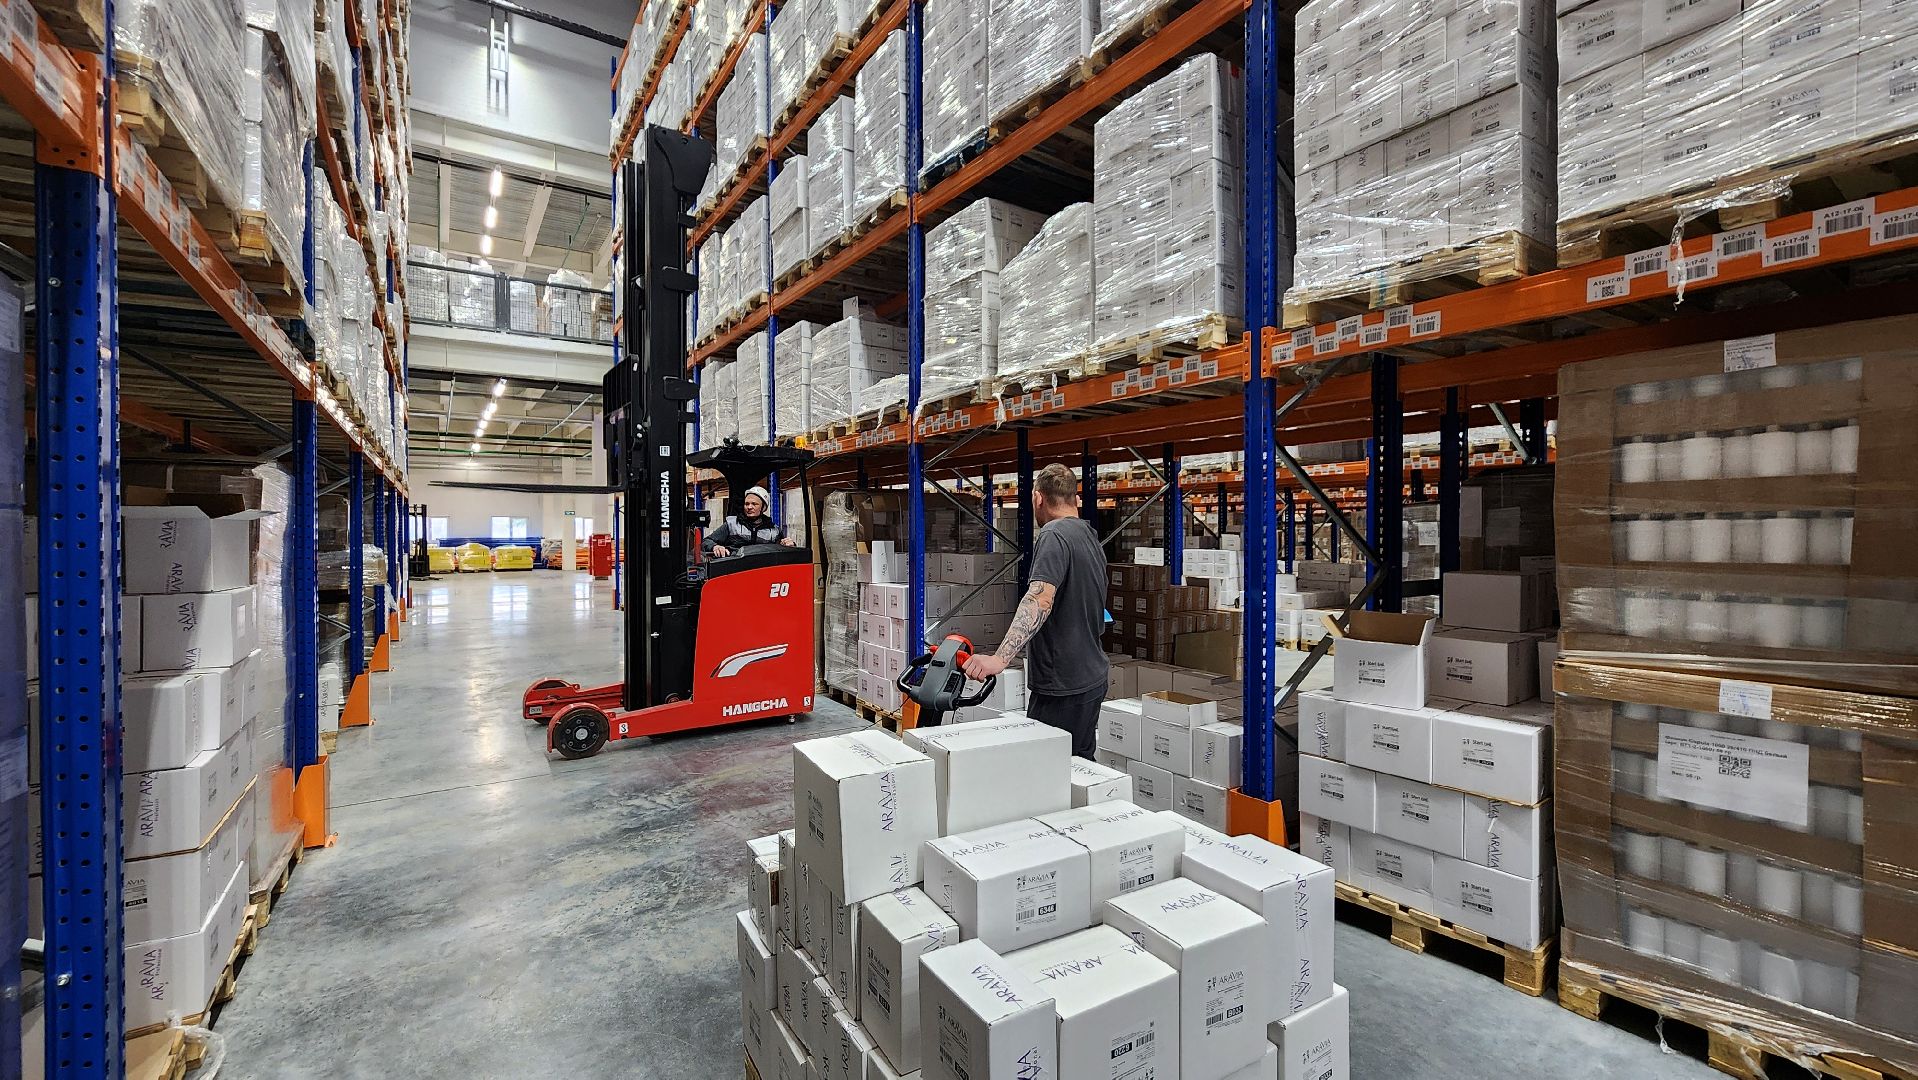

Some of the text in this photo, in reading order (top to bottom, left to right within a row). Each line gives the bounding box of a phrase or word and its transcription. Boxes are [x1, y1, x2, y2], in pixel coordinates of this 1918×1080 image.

[660, 471, 670, 528] HANGCHA
[770, 583, 789, 598] 20
[722, 698, 788, 717] HANGCHA
[880, 772, 894, 832] ARAVIA
[953, 841, 1005, 857] ARAVIA
[1491, 833, 1501, 868] ARAVIA
[1161, 892, 1211, 912] ARAVIA
[1043, 955, 1103, 980] ARAVIA
[1219, 970, 1244, 985] ARAVIA
[971, 966, 1023, 1003] ARAVIA
